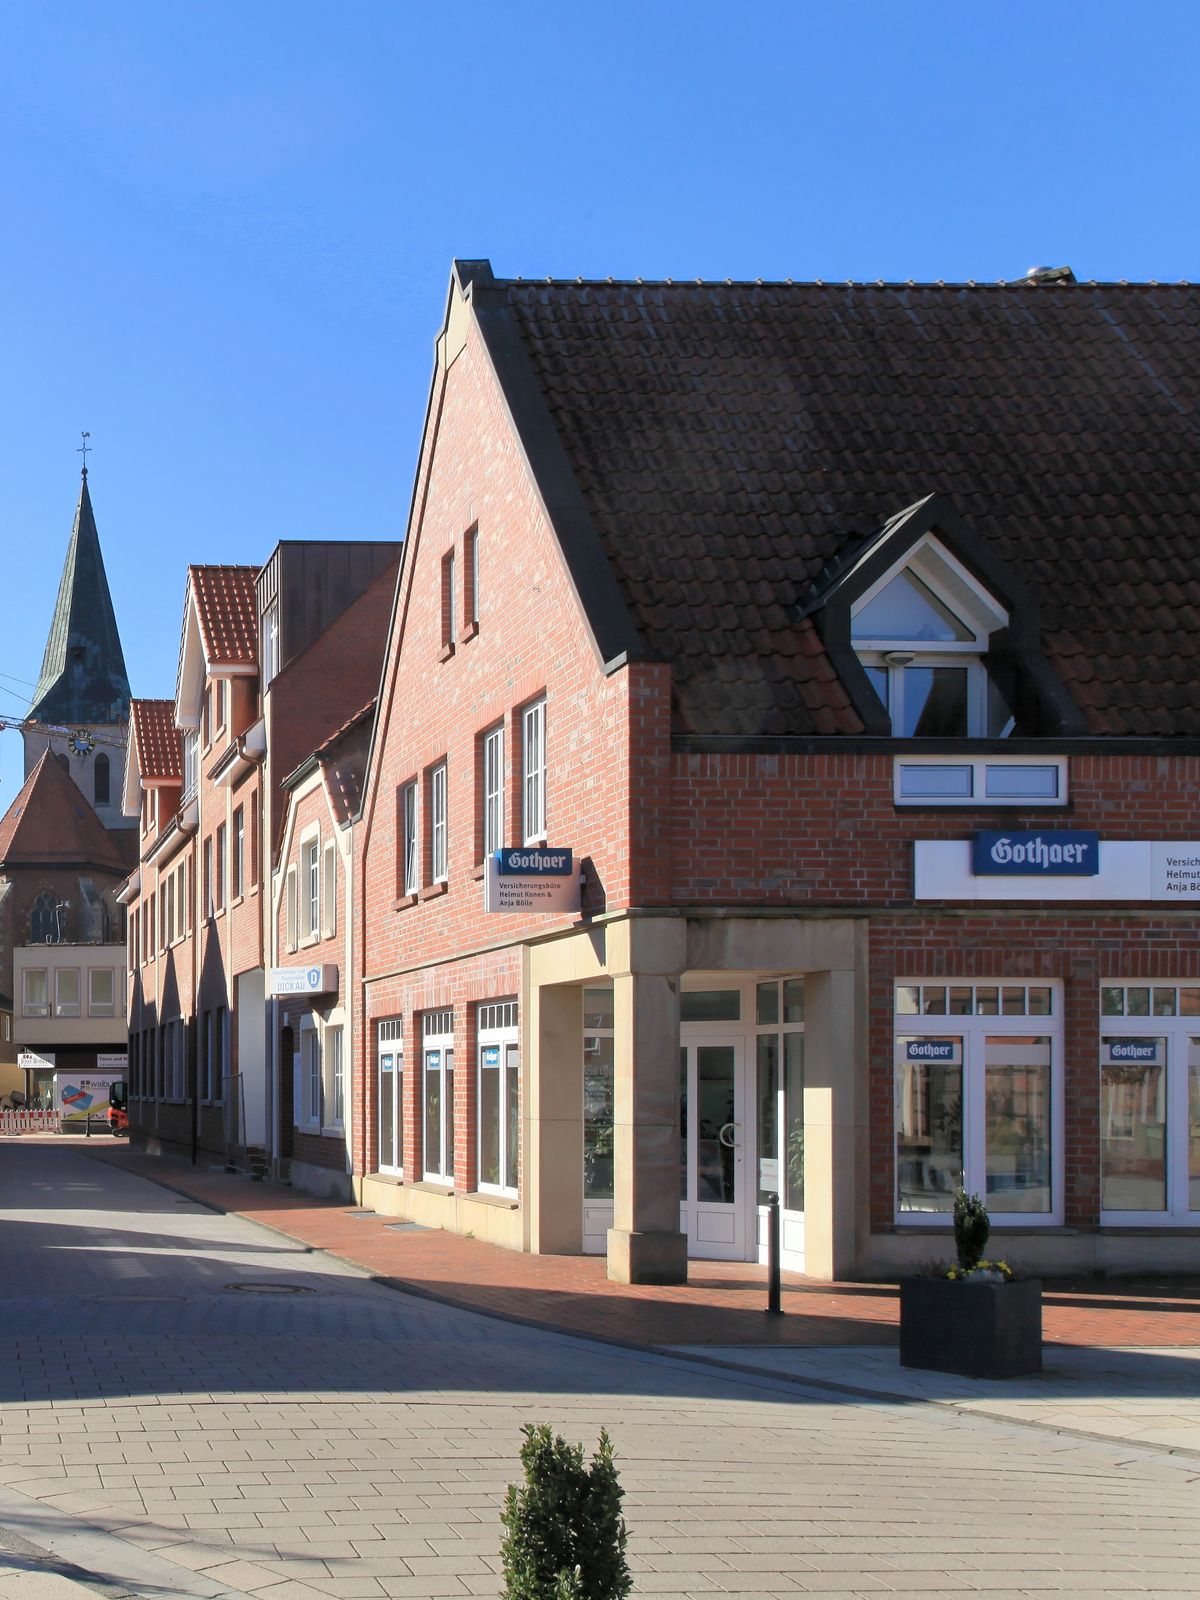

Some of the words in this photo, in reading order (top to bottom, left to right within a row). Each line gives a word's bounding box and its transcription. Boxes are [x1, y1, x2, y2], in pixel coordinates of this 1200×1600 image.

[990, 837, 1089, 869] Gothaer
[508, 851, 567, 871] Gothaer
[499, 882, 561, 891] Versicherungsbüro
[1166, 882, 1187, 893] Anja
[499, 899, 514, 907] Anja
[310, 971, 317, 985] D
[277, 982, 306, 992] DICKAU
[909, 1043, 951, 1057] Gothaer
[1112, 1044, 1154, 1058] Gothaer
